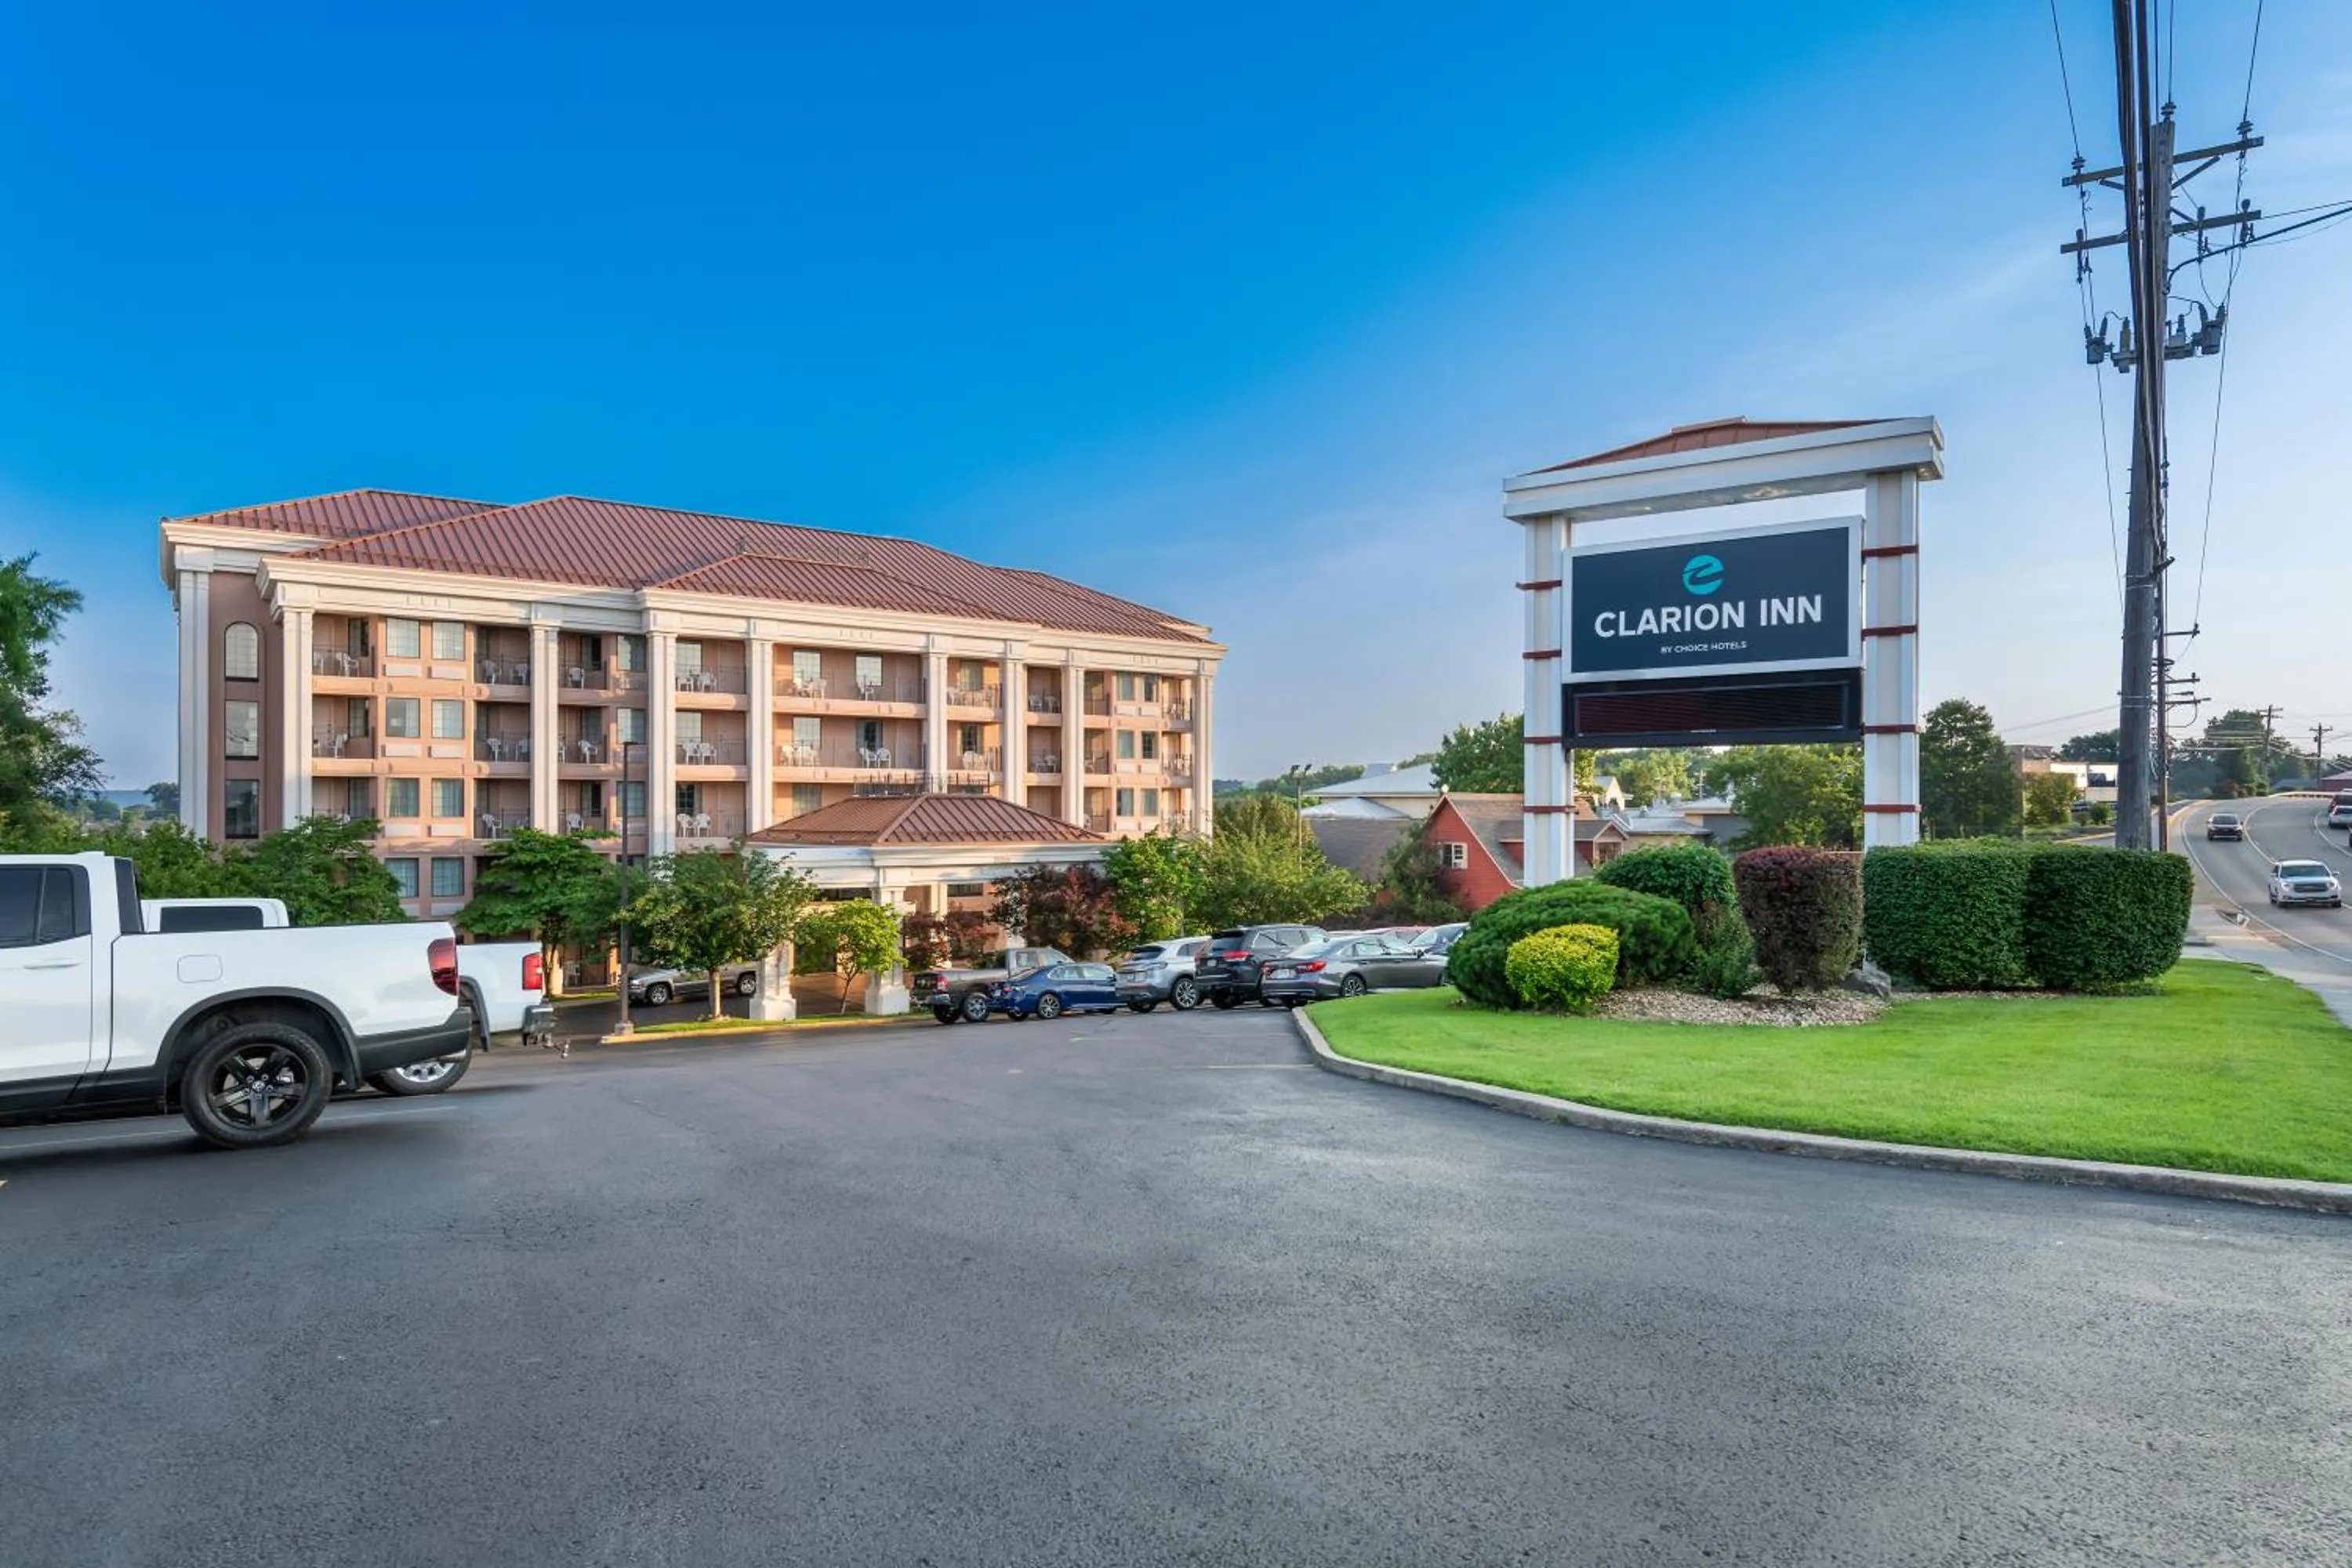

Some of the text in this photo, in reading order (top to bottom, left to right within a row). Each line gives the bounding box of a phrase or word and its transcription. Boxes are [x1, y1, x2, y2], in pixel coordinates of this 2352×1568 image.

[1595, 594, 1821, 637] CLARION INN
[1675, 644, 1708, 653] CHOICE
[1711, 641, 1748, 650] HOTELS
